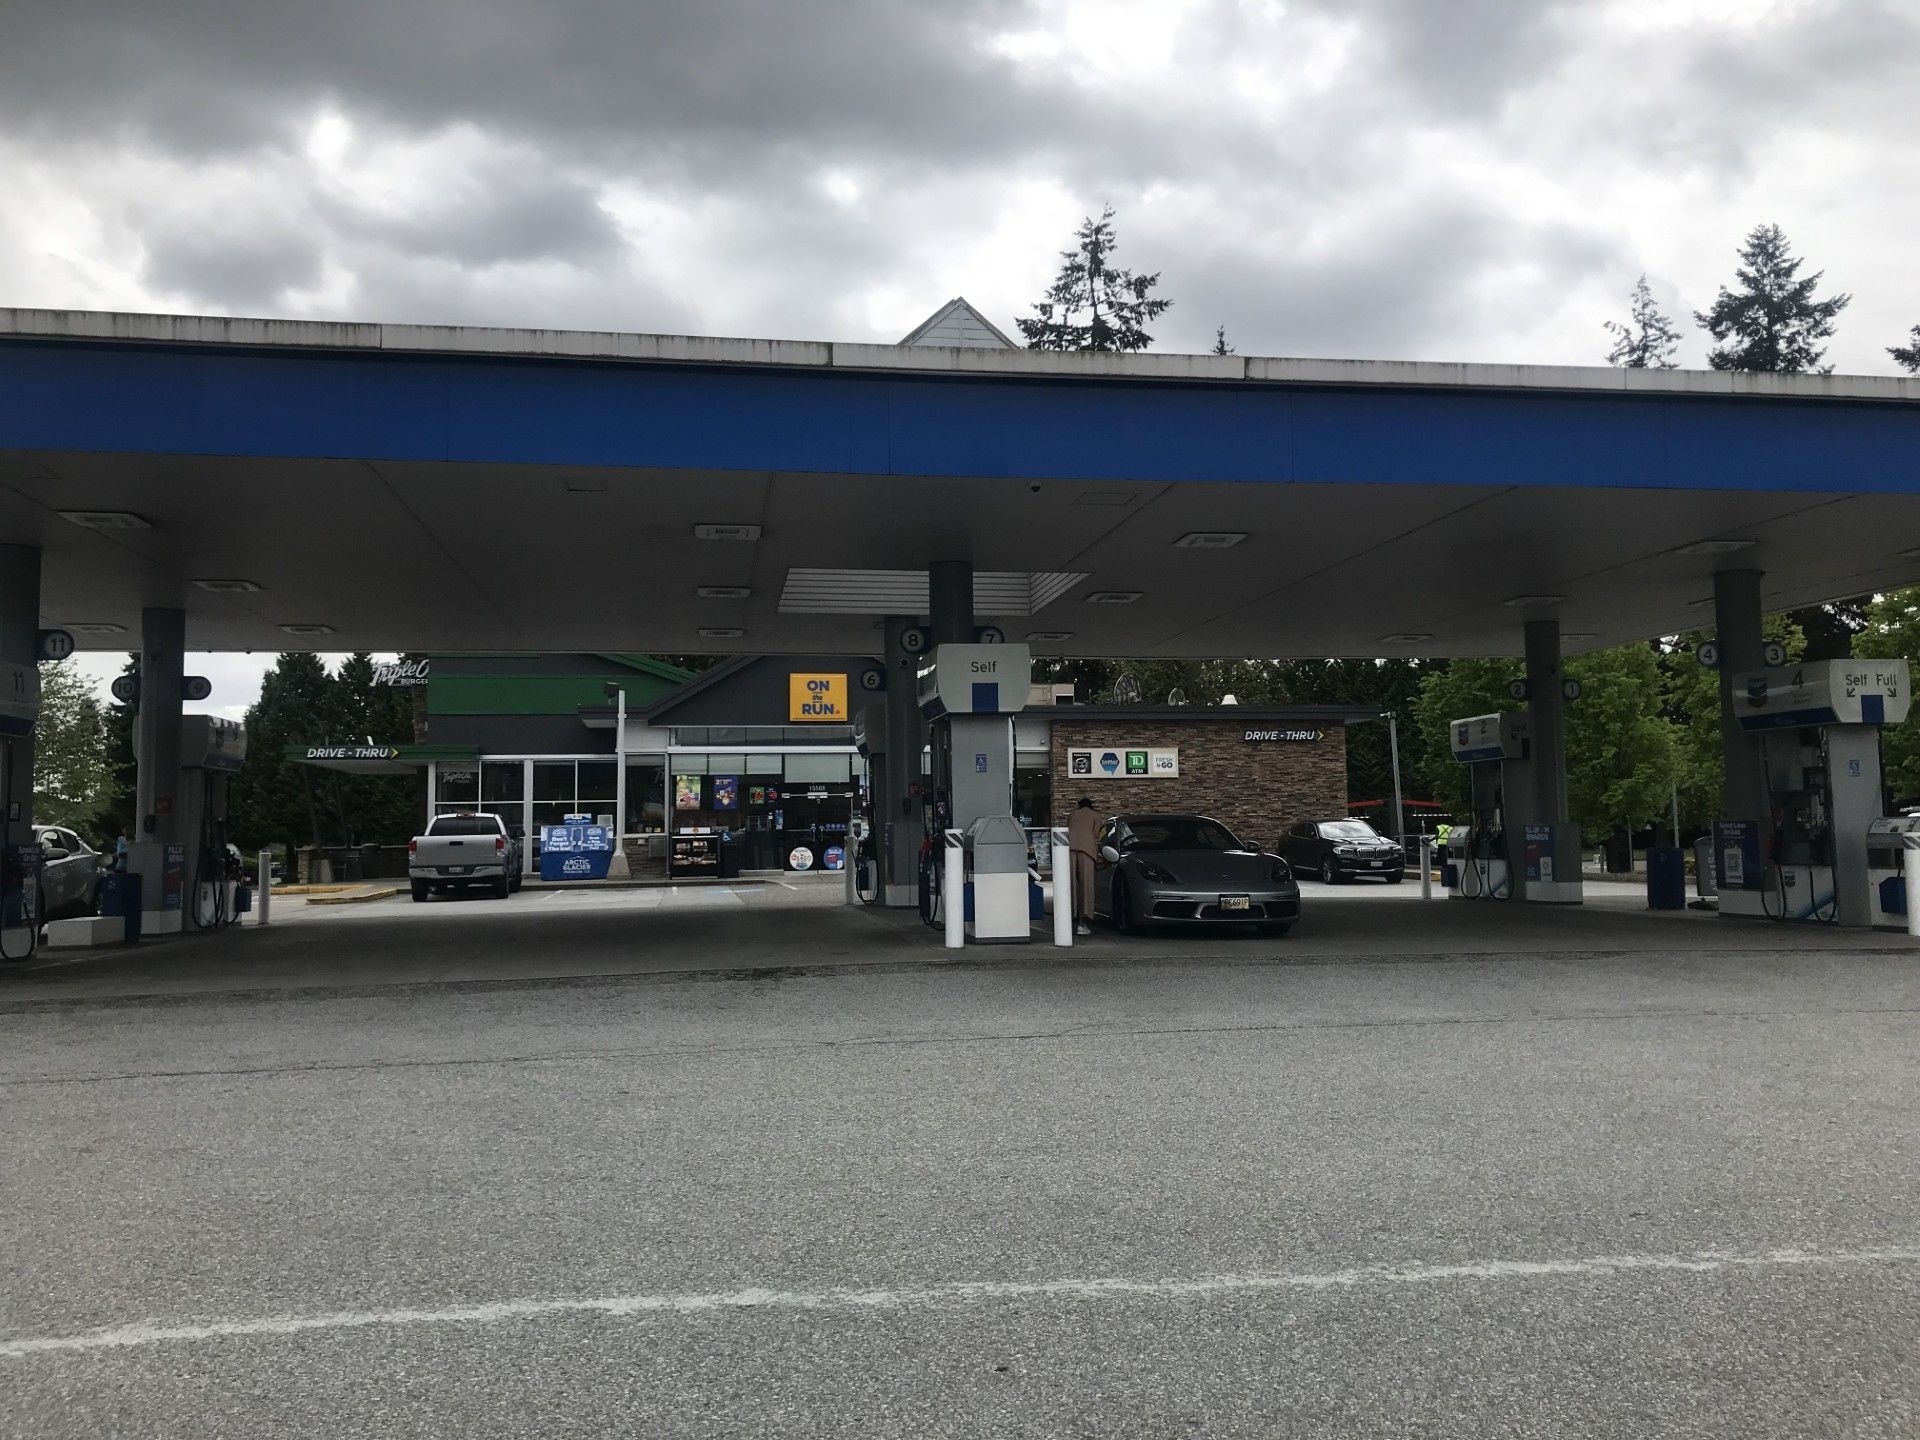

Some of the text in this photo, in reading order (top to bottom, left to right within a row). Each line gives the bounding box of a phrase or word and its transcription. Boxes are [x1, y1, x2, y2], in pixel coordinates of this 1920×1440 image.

[907, 633, 919, 647] 8
[985, 633, 996, 643] 7
[50, 637, 65, 652] 11
[1703, 649, 1713, 660] 4
[1770, 649, 1780, 660] 3
[971, 660, 997, 673] Self
[11, 670, 25, 695] 11
[866, 674, 876, 686] 6
[1791, 669, 1803, 689] 4
[1845, 674, 1897, 686] Self Full
[118, 682, 133, 694] 10
[194, 682, 204, 694] 9
[806, 680, 830, 692] ON
[802, 703, 835, 715] RUN
[1480, 720, 1488, 734] 2
[1130, 755, 1144, 766] TD
